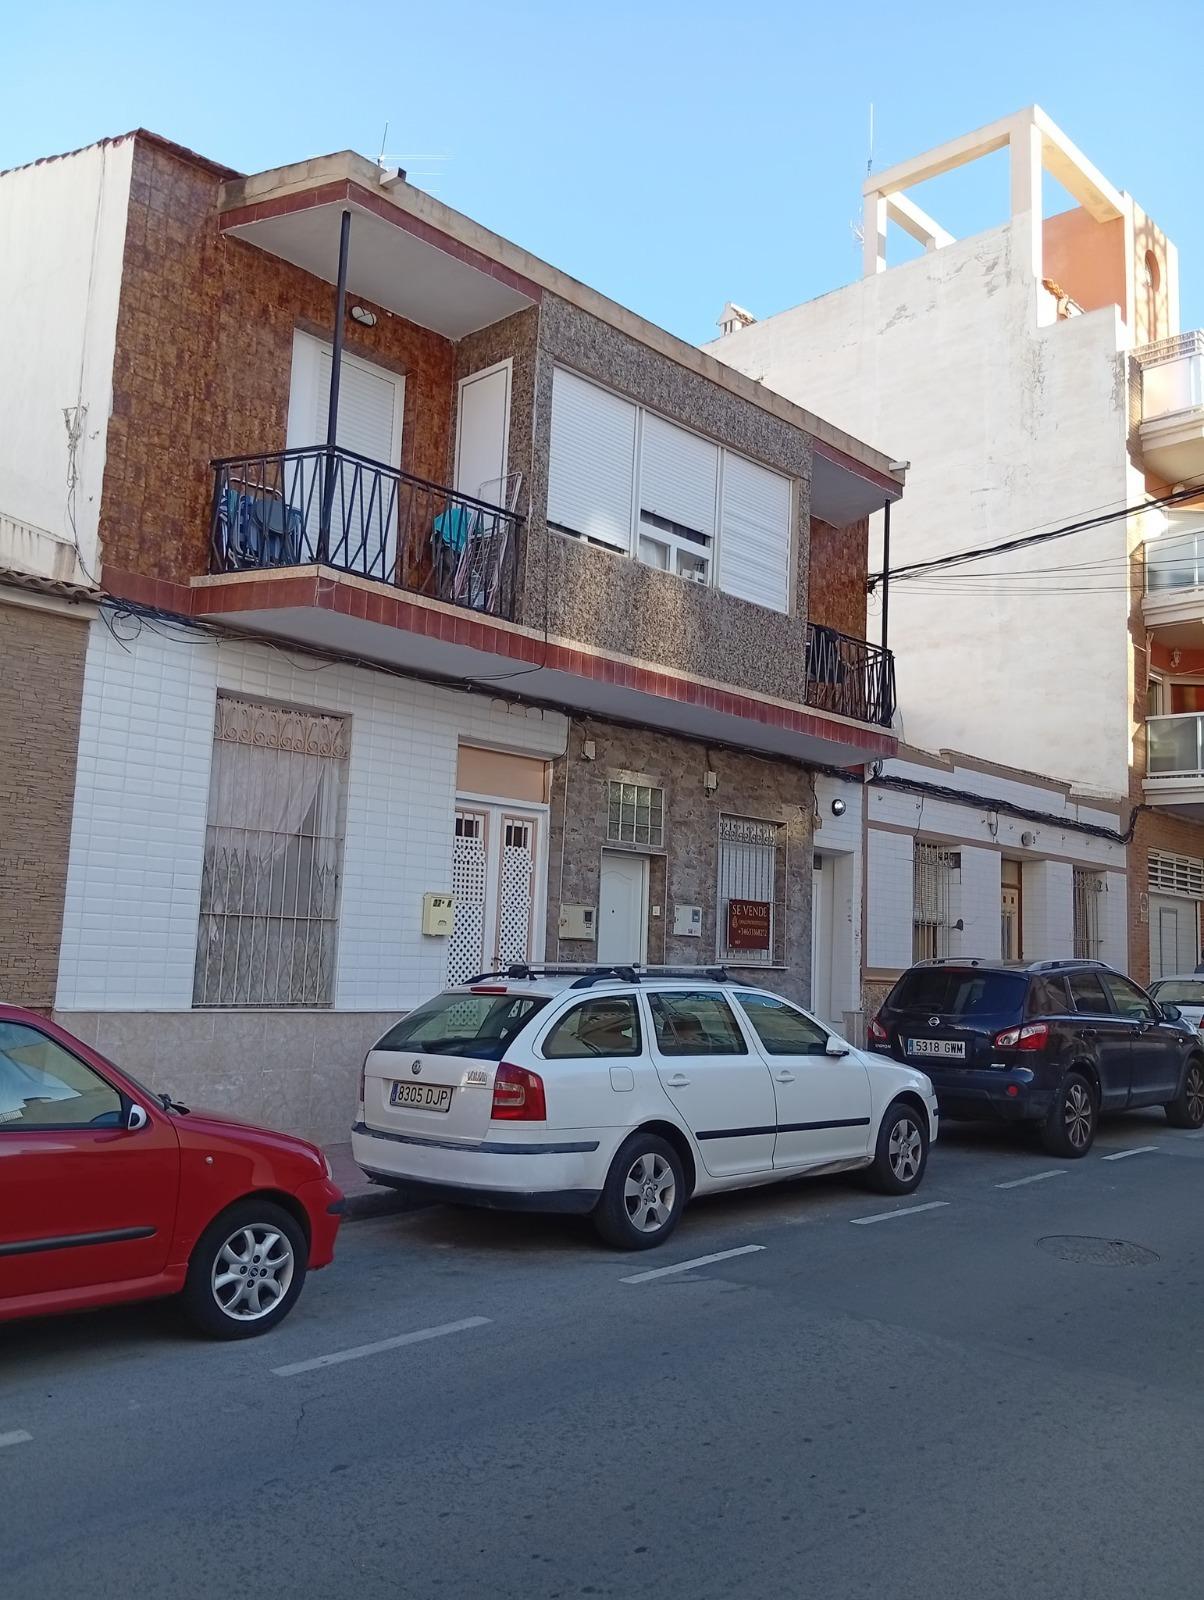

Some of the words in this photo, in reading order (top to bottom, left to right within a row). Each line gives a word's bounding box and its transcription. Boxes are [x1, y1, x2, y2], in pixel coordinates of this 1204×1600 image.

[732, 904, 742, 915] SE
[743, 905, 768, 917] VENDE
[916, 1041, 940, 1052] 5318
[944, 1043, 963, 1054] GWM
[398, 1086, 423, 1103] 8305
[426, 1089, 448, 1106] DJP
